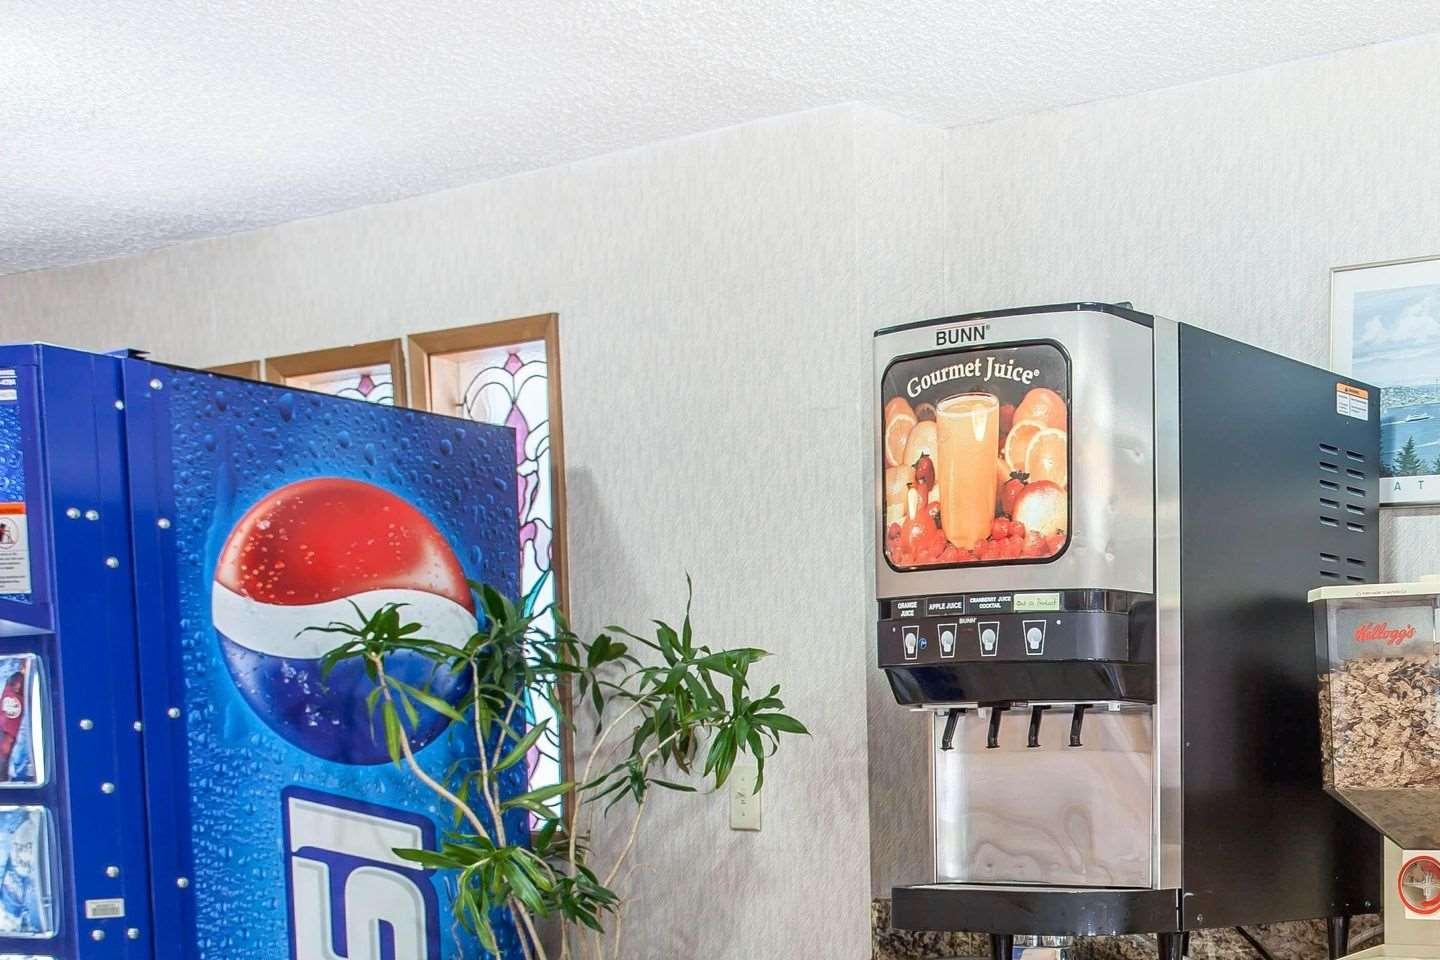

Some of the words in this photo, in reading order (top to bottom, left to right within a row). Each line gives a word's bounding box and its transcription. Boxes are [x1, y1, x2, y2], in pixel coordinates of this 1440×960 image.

[907, 358, 981, 398] Gourmet
[897, 601, 918, 610] ORANGE
[946, 601, 962, 609] JUICE
[900, 609, 915, 617] JUICE
[1353, 621, 1416, 646] Kellogg's
